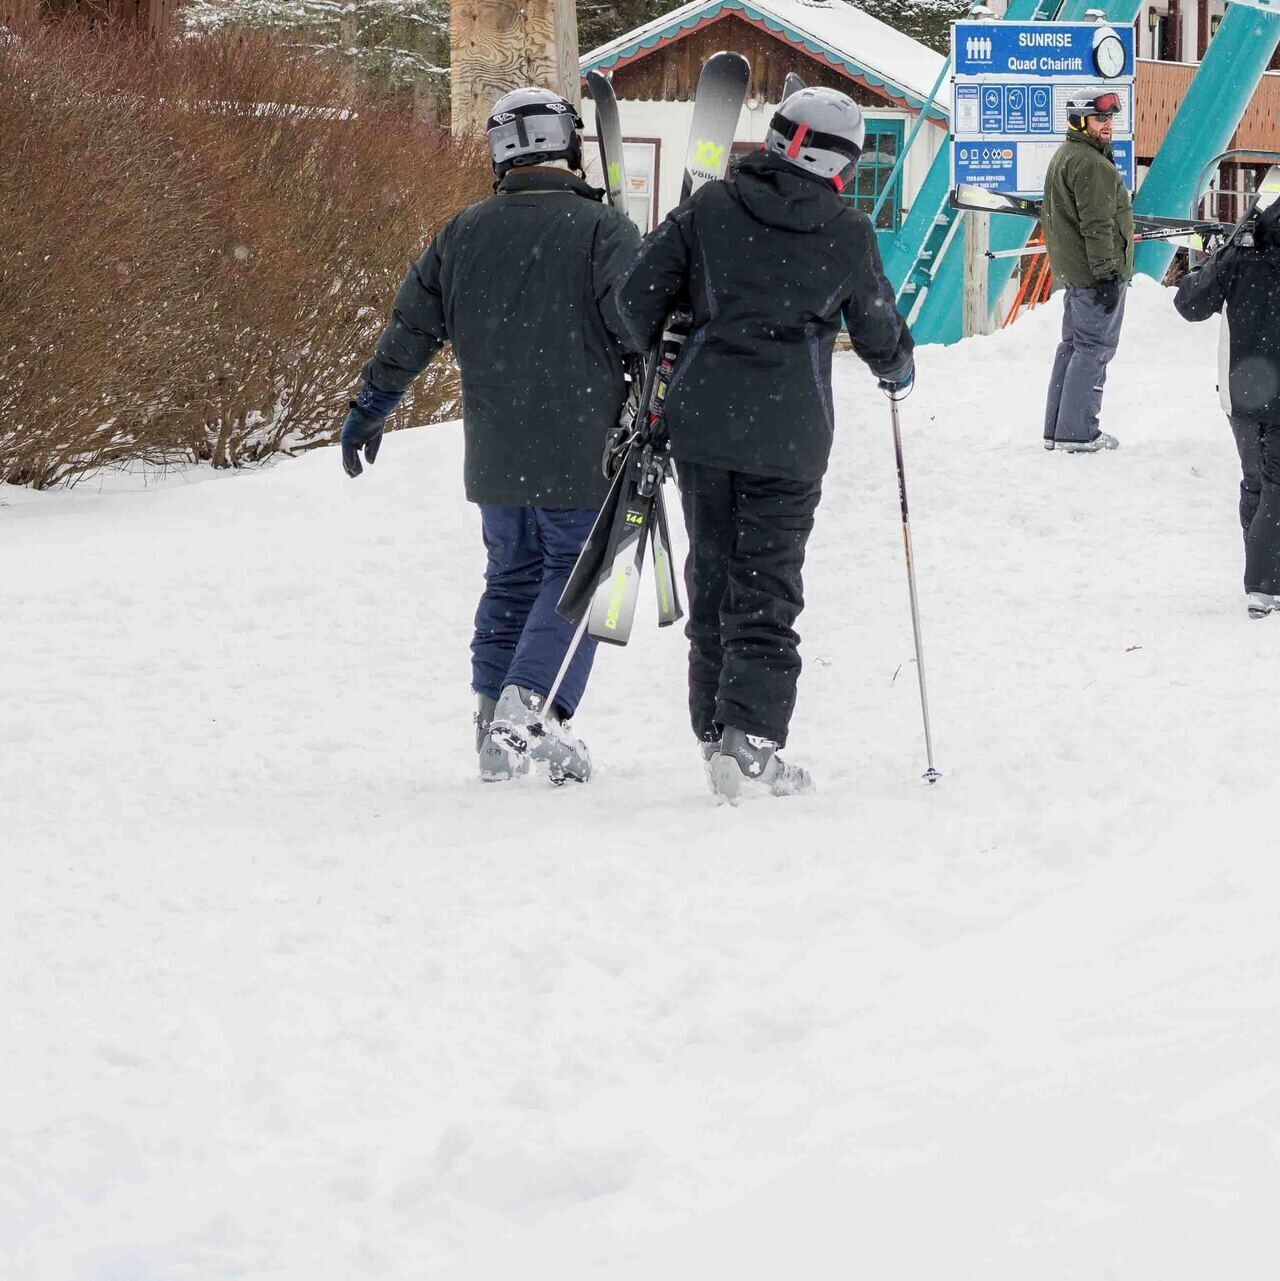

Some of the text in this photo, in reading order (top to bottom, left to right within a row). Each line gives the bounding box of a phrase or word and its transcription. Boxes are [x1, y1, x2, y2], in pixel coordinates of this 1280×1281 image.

[1019, 33, 1072, 47] SUNRISE
[1008, 57, 1083, 71] Quad Chairlift
[626, 513, 643, 524] 144
